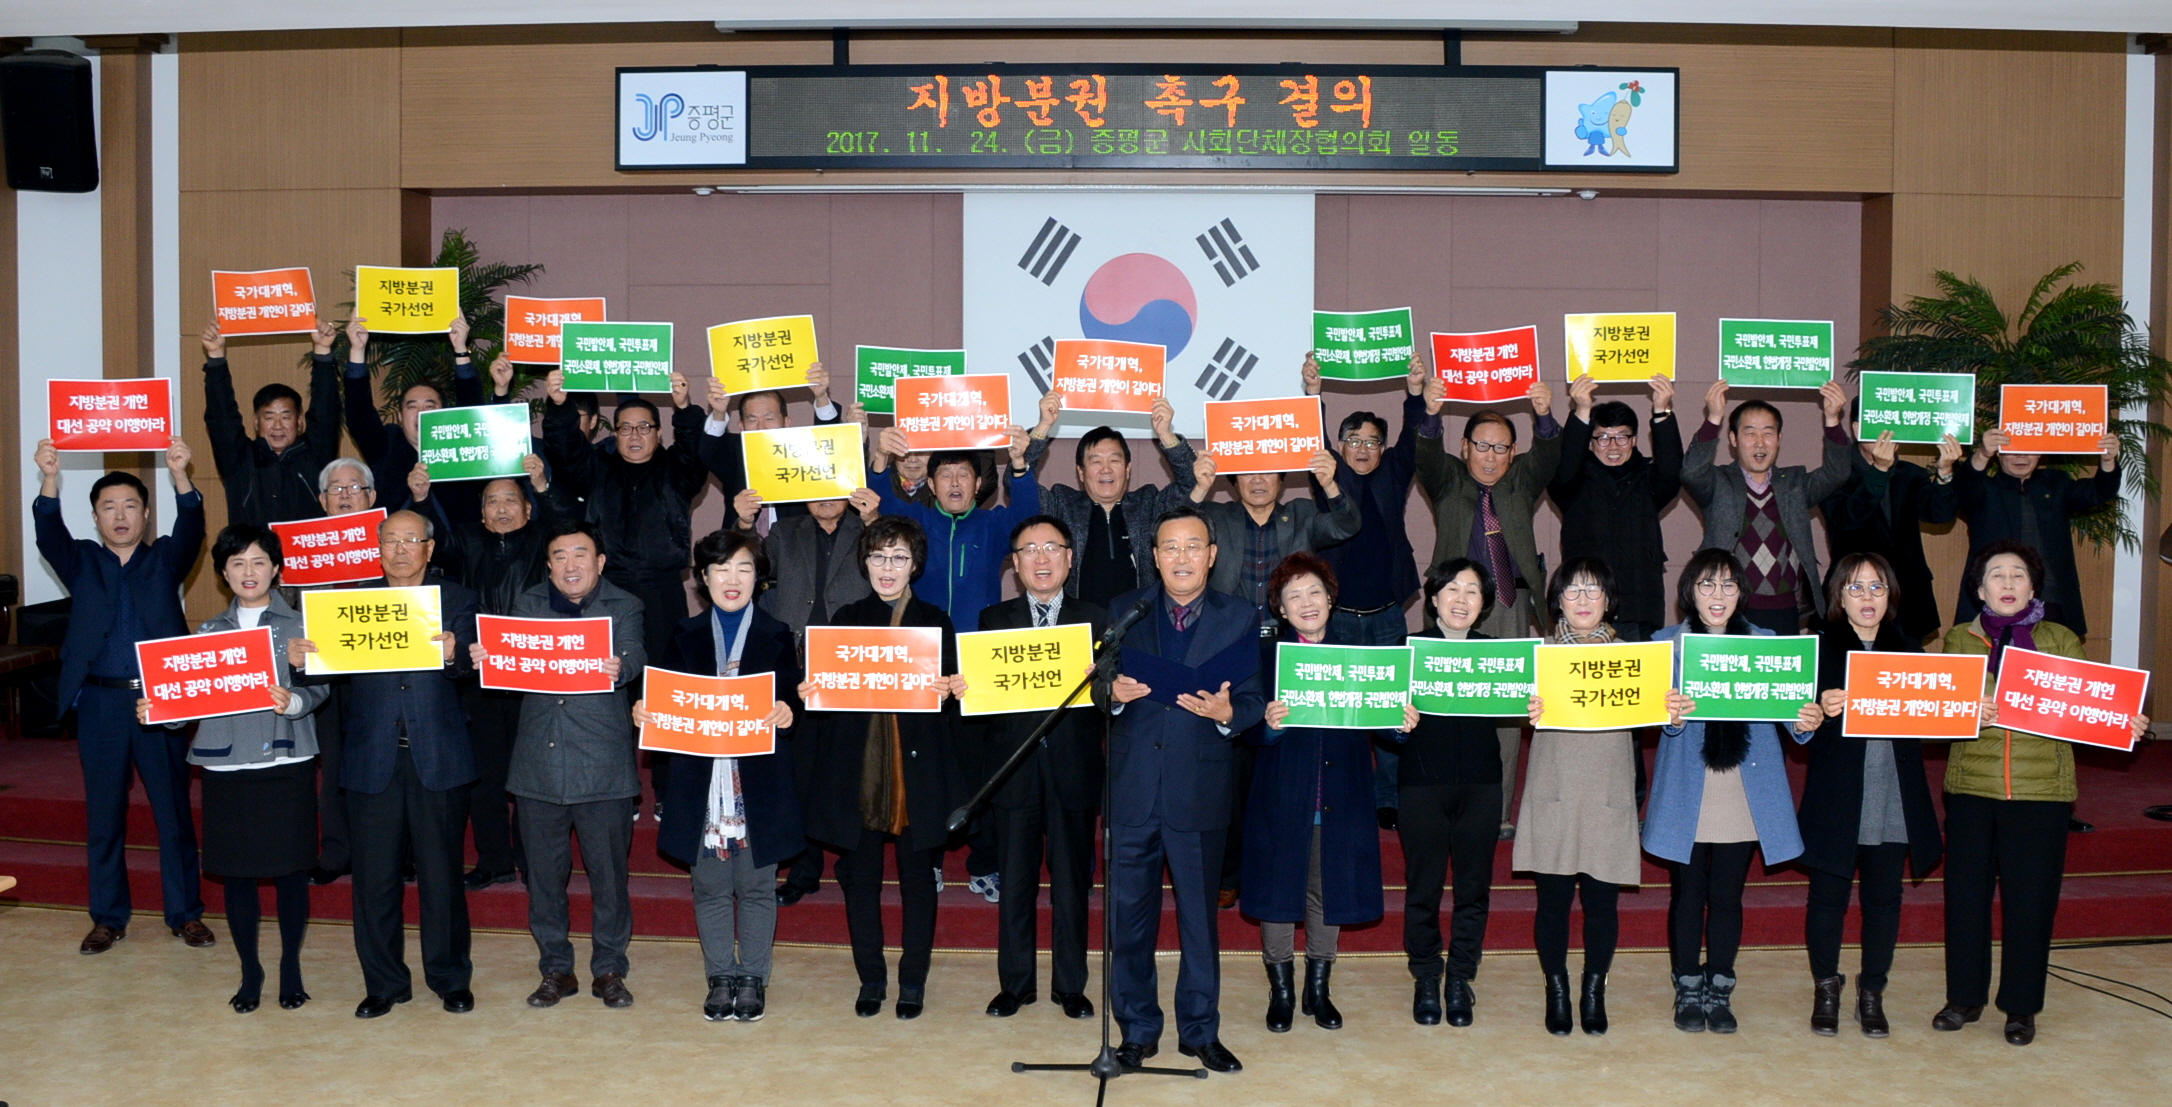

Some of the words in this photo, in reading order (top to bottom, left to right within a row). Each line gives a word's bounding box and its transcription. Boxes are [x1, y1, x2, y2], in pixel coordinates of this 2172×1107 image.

[907, 74, 1106, 128] 지방분권
[1145, 74, 1245, 128] 촉구
[1279, 74, 1372, 129] 결의
[686, 104, 735, 131] 증평군
[670, 132, 697, 144] Jeung
[700, 132, 734, 144] Pyeong
[826, 131, 890, 154] 2017.
[907, 131, 942, 154] 11.
[970, 131, 1007, 154] 24.
[1024, 129, 1074, 155] (금)
[1090, 129, 1168, 155] 증평군
[1182, 129, 1392, 155] 사회단체장협의회
[1407, 129, 1459, 156] 일동
[234, 282, 298, 299] 국가대개혁,
[379, 280, 434, 295] 지방분권
[218, 304, 256, 320] 지방분권
[259, 304, 288, 318] 개헌이
[291, 302, 316, 316] 길이다
[380, 301, 434, 317] 국가선언
[508, 333, 544, 347] 지방분권
[733, 330, 791, 350] 지방분권
[1325, 327, 1366, 342] 국민발안제,
[1368, 324, 1402, 341] 국민투표제
[1594, 326, 1650, 341] 지방분권
[1735, 333, 1777, 349] 국민발안제,
[1779, 334, 1818, 349] 국민투표제
[575, 337, 617, 352] 국민발안제,
[619, 338, 657, 352] 국민투표제
[1450, 345, 1495, 362] 지방분권
[1497, 343, 1519, 359] 개헌
[737, 353, 794, 373] 국가선언
[1315, 348, 1352, 363] 국민소환제,
[1353, 348, 1380, 363] 헌법개정
[1382, 345, 1412, 362] 국민발안제
[1594, 349, 1650, 364] 국가선언
[1723, 355, 1762, 371] 국민소환제,
[1763, 356, 1791, 371] 헌법개정
[1793, 357, 1829, 371] 국민발안제
[564, 360, 602, 375] 국민소환제,
[604, 360, 631, 375] 헌법개정
[633, 361, 669, 376] 국민발안제
[870, 362, 910, 377] 국민발안제,
[1077, 355, 1143, 372] 국가대개혁,
[1442, 369, 1465, 383] 대선
[1467, 369, 1488, 385] 공약
[1491, 364, 1533, 383] 이행하라
[1057, 378, 1096, 393] 지방분권
[1099, 379, 1129, 394] 개헌이
[1132, 381, 1161, 396] 길이다
[1875, 387, 1916, 403] 국민발안제,
[1919, 389, 1958, 403] 국민투표제
[69, 395, 120, 410] 지방분권
[123, 394, 148, 409] 개헌
[918, 391, 987, 407] 국가대개혁,
[2024, 400, 2086, 415] 국가대개혁,
[57, 419, 85, 433] 대선
[87, 418, 114, 433] 공약
[116, 417, 165, 432] 이행하라
[899, 415, 940, 432] 지방분권
[943, 415, 975, 430] 개헌이
[977, 414, 1008, 429] 길이다
[1231, 413, 1299, 431] 국가대개혁,
[1863, 410, 1902, 425] 국민소환제,
[1903, 410, 1931, 426] 헌법개정
[1932, 411, 1969, 426] 국민발안제
[431, 424, 472, 440] 국민발안제,
[2004, 422, 2043, 436] 지방분권
[2045, 422, 2074, 436] 개헌이
[2076, 422, 2103, 436] 길이다
[422, 448, 458, 464] 국민소환제,
[460, 445, 489, 462] 헌법개정
[1211, 439, 1253, 456] 지방분권
[1256, 438, 1288, 454] 개헌이
[1290, 436, 1320, 452] 길이다
[775, 464, 836, 483] 국가선언
[291, 530, 340, 549] 지방분권
[342, 526, 366, 542] 개헌
[284, 555, 309, 570] 대선
[311, 552, 335, 568] 공약
[337, 603, 408, 623] 지방분권
[340, 631, 409, 650] 국가선언
[501, 633, 554, 650] 지방분권
[557, 635, 584, 651] 개헌
[163, 650, 217, 672] 지방분권
[219, 647, 247, 666] 개헌
[835, 645, 913, 663] 국가대개혁,
[991, 642, 1061, 664] 지방분권
[490, 655, 516, 671] 대선
[519, 657, 546, 673] 공약
[548, 658, 604, 674] 이행하라
[1424, 656, 1473, 673] 국민발안제,
[1478, 657, 1524, 673] 국민투표제
[1569, 659, 1641, 680] 지방분권
[1700, 654, 1751, 672] 국민발안제,
[1754, 655, 1801, 672] 국민투표제
[813, 672, 860, 690] 지방분권
[863, 673, 898, 690] 개헌이
[901, 673, 935, 689] 길이다
[994, 669, 1062, 691] 국가선언
[1294, 663, 1345, 681] 국민발안제,
[1348, 665, 1395, 682] 국민투표제
[1877, 671, 1956, 691] 국가대개혁,
[153, 683, 182, 701] 대선
[184, 679, 212, 696] 공약
[214, 671, 269, 693] 이행하라
[1412, 680, 1455, 697] 국민소환제,
[1457, 681, 1490, 698] 헌법개정
[1492, 681, 1535, 698] 국민발안제
[1684, 681, 1731, 699] 국민소환제,
[1734, 682, 1769, 700] 헌법개정
[1770, 682, 1813, 700] 국민발안제
[2023, 668, 2083, 693] 지방분권
[2085, 681, 2115, 700] 개헌
[671, 689, 749, 711] 국가대개혁,
[1280, 689, 1325, 707] 국민소환제,
[1328, 691, 1362, 708] 헌법개정
[1364, 691, 1407, 708] 국민발안제
[1570, 688, 1640, 708] 국가선언
[1851, 698, 1900, 716] 지방분권
[1903, 699, 1939, 717] 개헌이
[1942, 701, 1978, 717] 길이다
[2004, 691, 2034, 711] 대선
[2037, 698, 2067, 717] 공약
[2070, 705, 2128, 729] 이행하라
[651, 712, 694, 734] 지방분권
[697, 721, 733, 736] 개헌이
